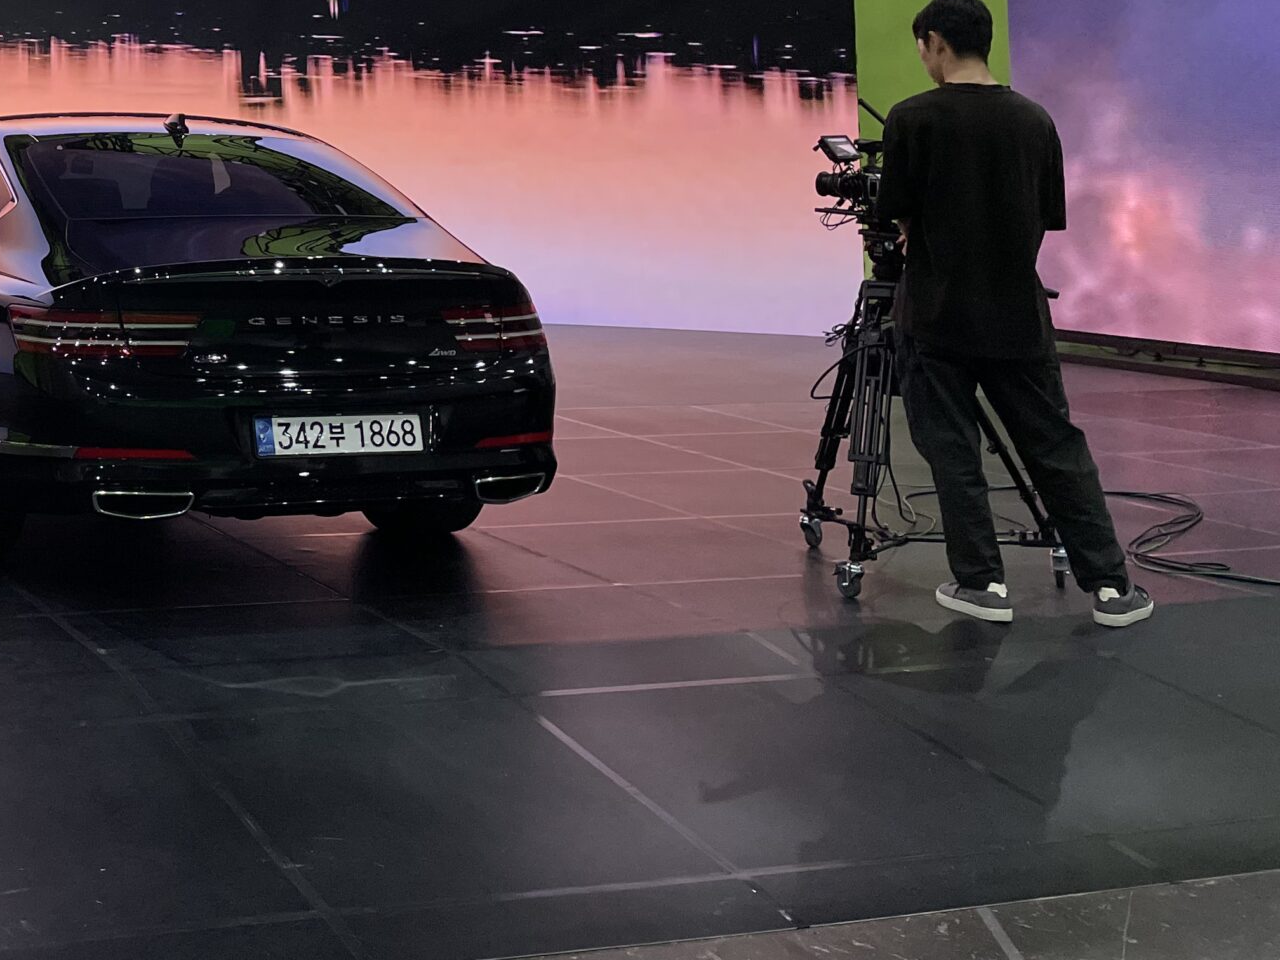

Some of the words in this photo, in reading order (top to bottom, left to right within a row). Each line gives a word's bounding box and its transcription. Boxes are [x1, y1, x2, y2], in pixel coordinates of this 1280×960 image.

[248, 315, 406, 326] GENESIS
[277, 421, 346, 450] 342부
[354, 419, 417, 448] 1868
